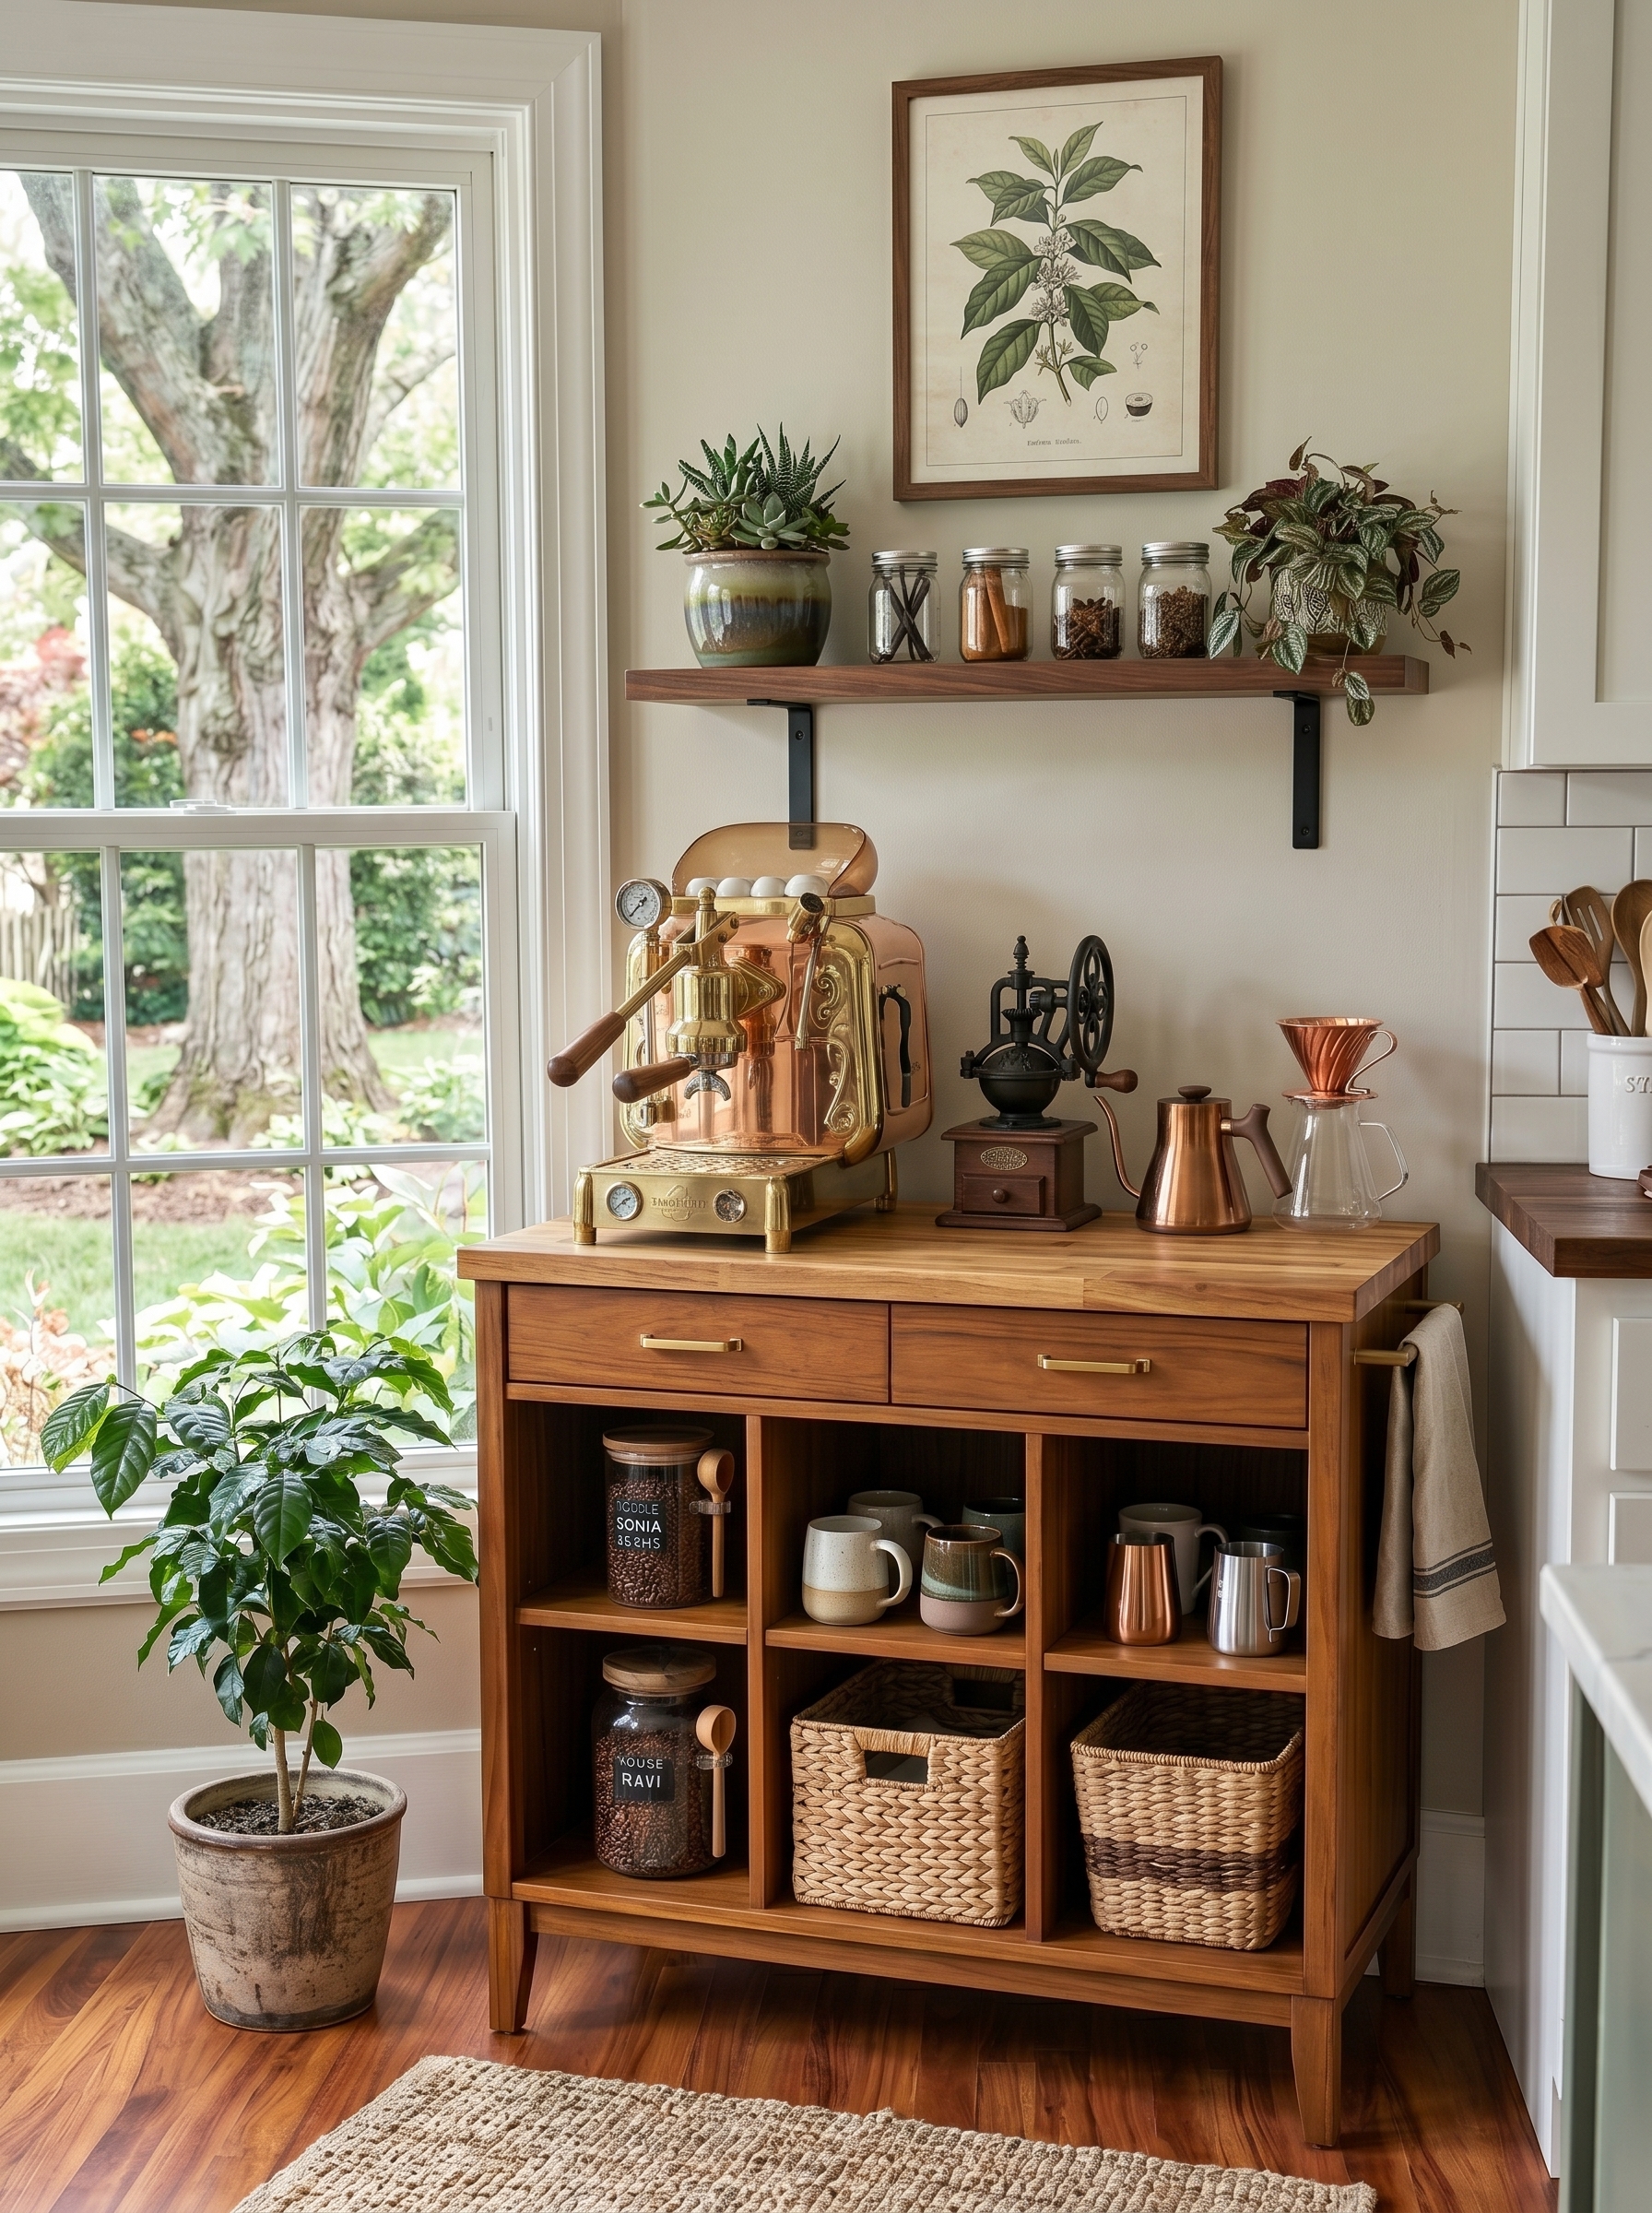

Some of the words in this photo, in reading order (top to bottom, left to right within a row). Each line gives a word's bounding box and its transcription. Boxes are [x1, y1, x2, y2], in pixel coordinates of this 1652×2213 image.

[1624, 1076, 1652, 1094] ST
[617, 1516, 662, 1533] SONIA
[621, 1772, 661, 1788] RAVI
